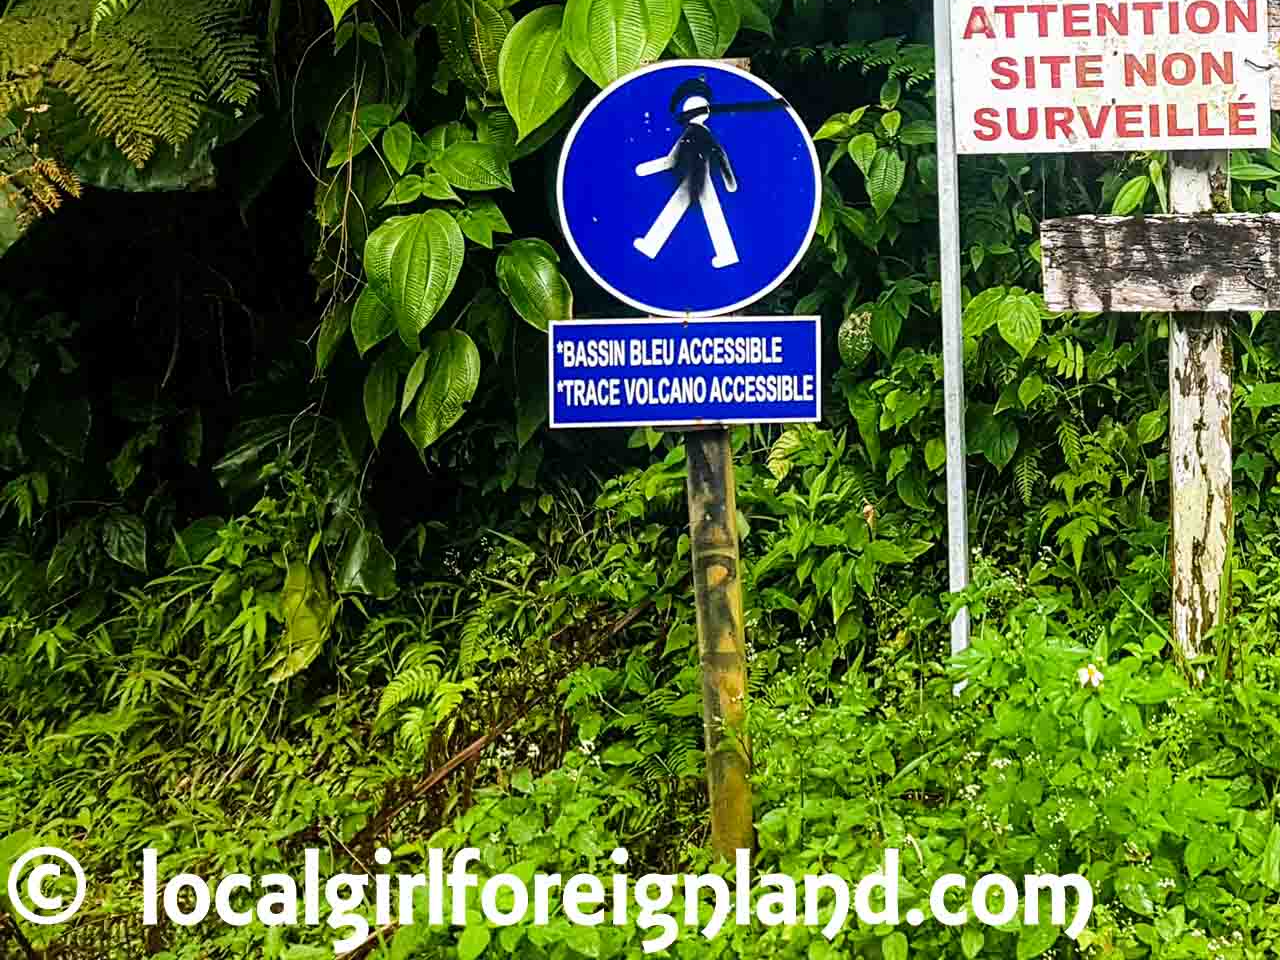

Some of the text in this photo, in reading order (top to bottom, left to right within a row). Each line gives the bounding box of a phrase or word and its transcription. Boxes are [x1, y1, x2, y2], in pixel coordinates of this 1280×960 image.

[962, 0, 1258, 39] ATTENTION
[990, 51, 1235, 90] SITE NON
[973, 93, 1258, 142] SURVEILLÉ
[629, 338, 675, 367] BLEU
[677, 336, 783, 366] ACCESSIBLE
[623, 375, 706, 405] VOLCANO
[709, 374, 814, 403] ACCESSIBLE
